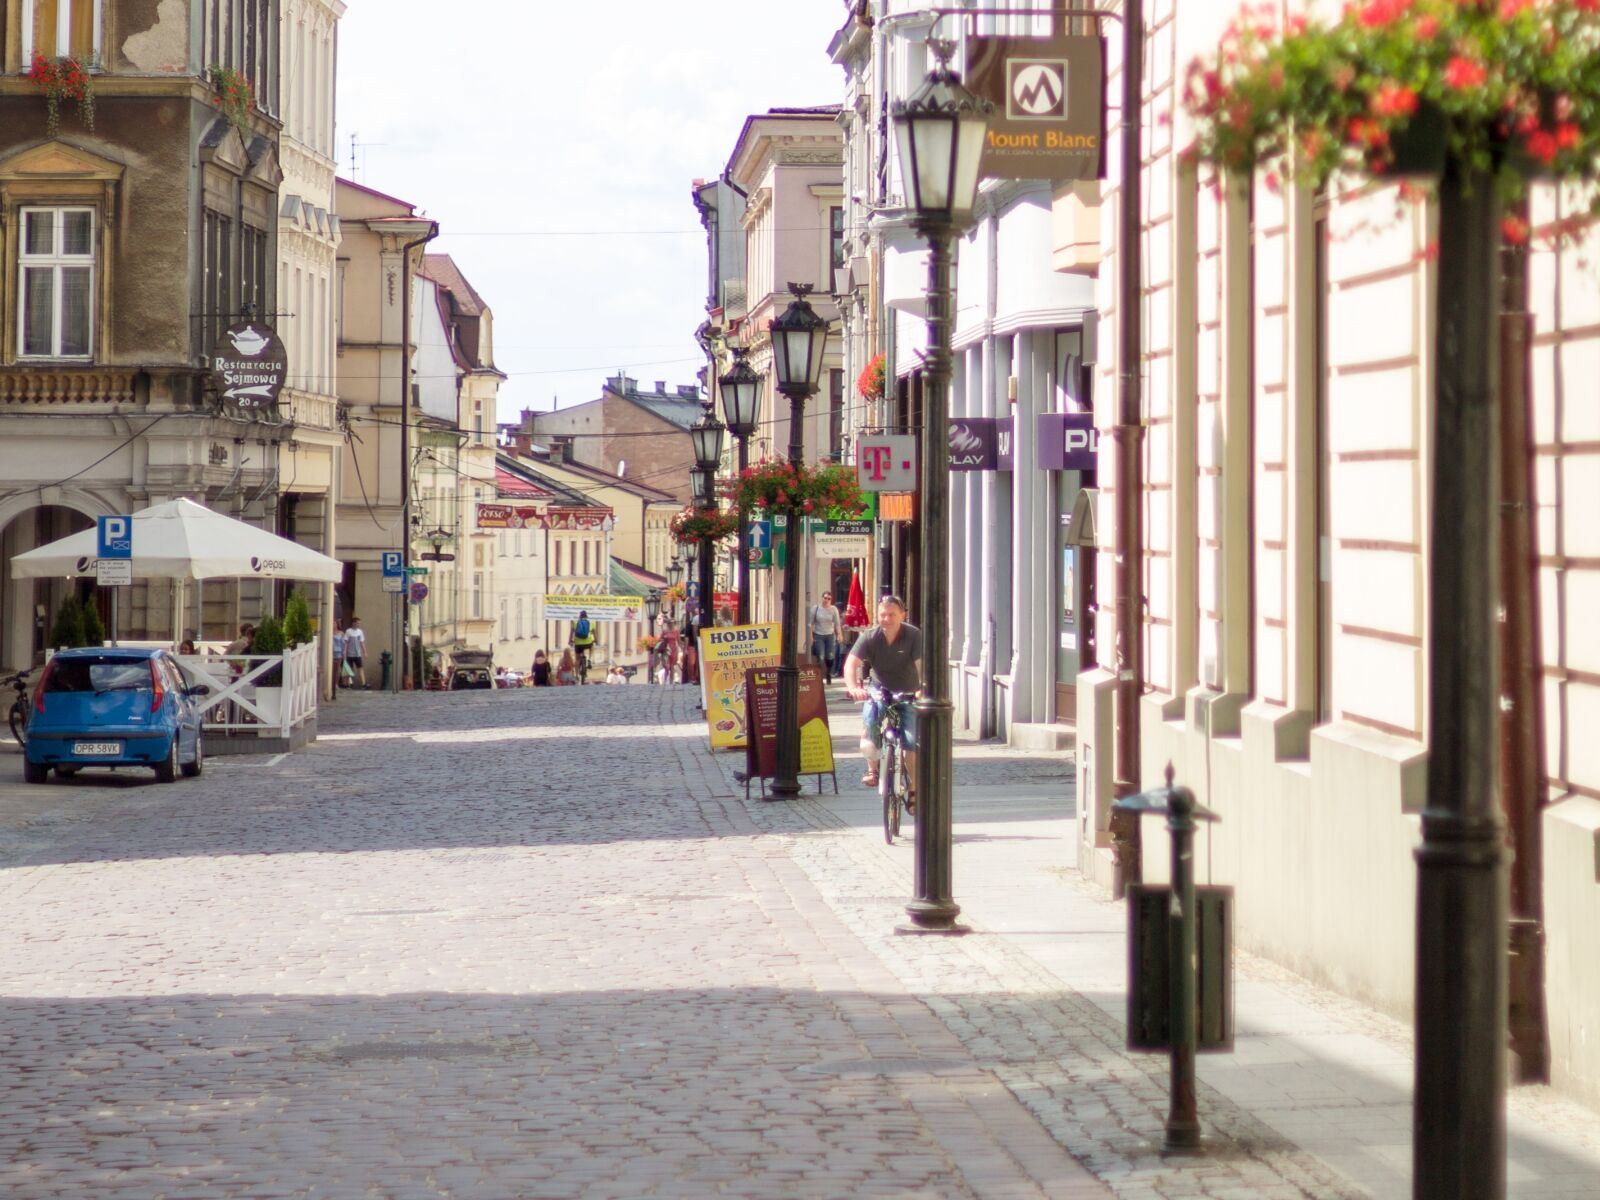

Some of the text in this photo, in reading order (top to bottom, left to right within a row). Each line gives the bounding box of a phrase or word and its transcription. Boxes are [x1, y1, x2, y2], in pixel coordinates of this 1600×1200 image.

[1046, 130, 1097, 148] Blanc
[215, 357, 282, 371] Restauracja
[223, 370, 277, 385] Sejmowa
[238, 397, 250, 407] 20
[105, 518, 126, 546] P
[386, 554, 398, 570] P
[710, 628, 771, 644] HOBBY
[717, 648, 768, 657] MODELARSKI
[712, 658, 774, 671] ZABAWKI
[756, 687, 774, 695] Skup
[76, 744, 118, 753] OPR 58VK
